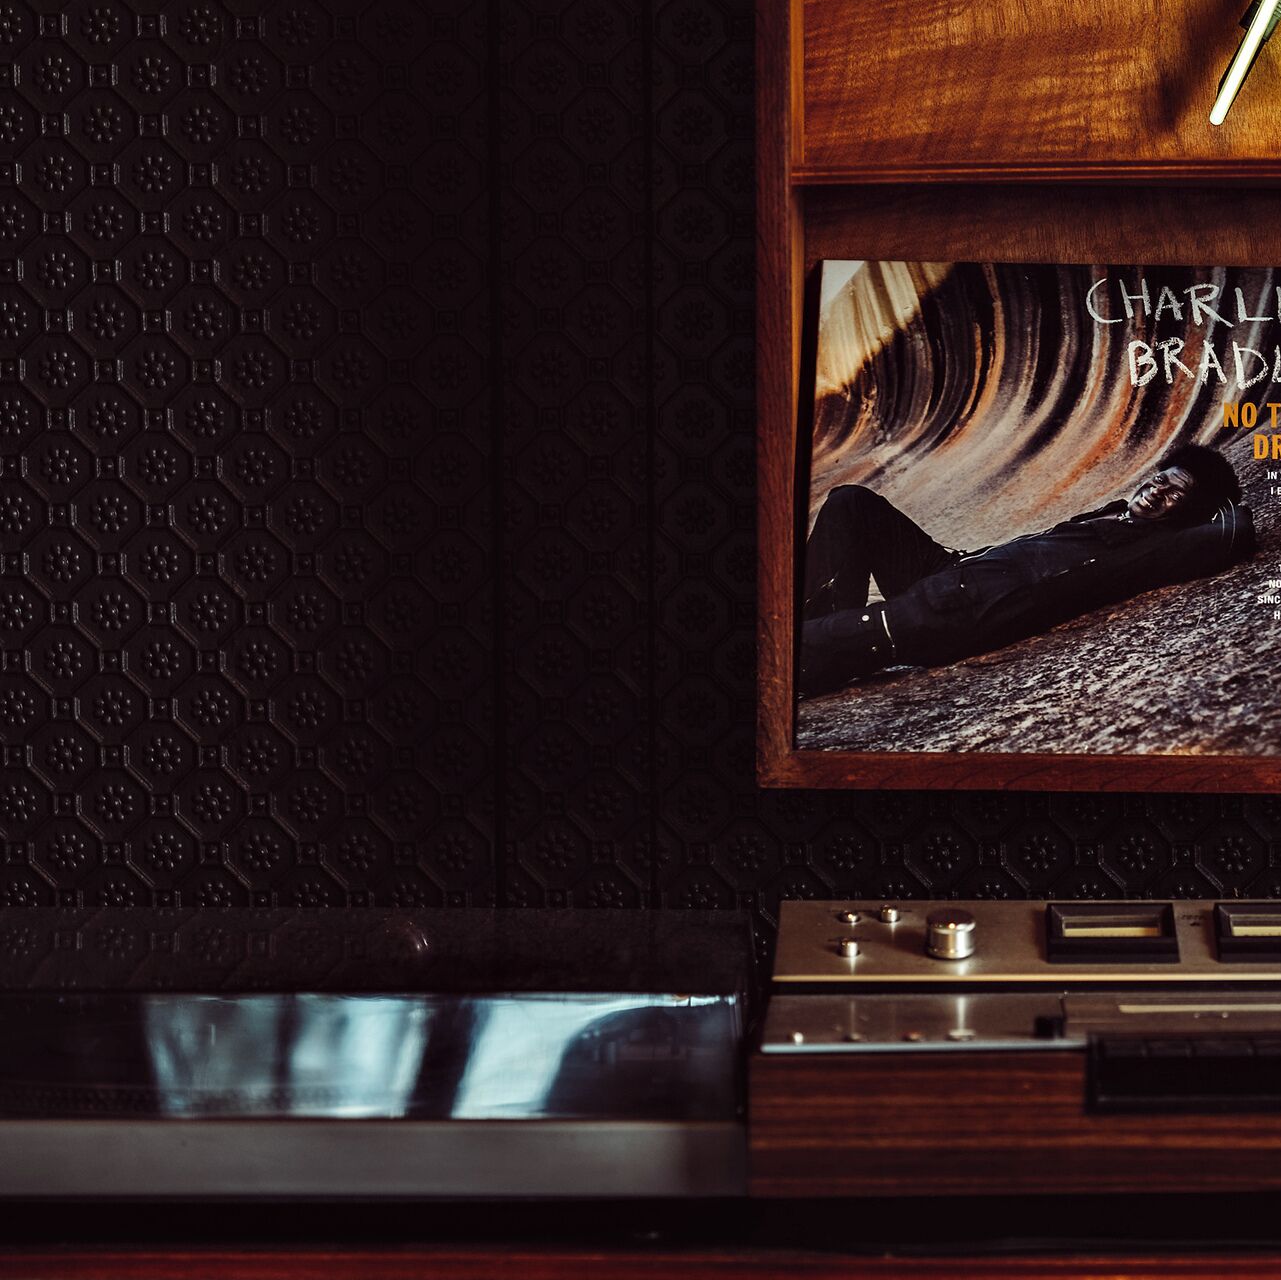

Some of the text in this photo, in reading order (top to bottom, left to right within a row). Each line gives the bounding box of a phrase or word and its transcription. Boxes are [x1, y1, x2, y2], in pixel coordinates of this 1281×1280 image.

[1223, 402, 1257, 428] NO
[1267, 471, 1278, 482] IN
[1270, 487, 1274, 496] I
